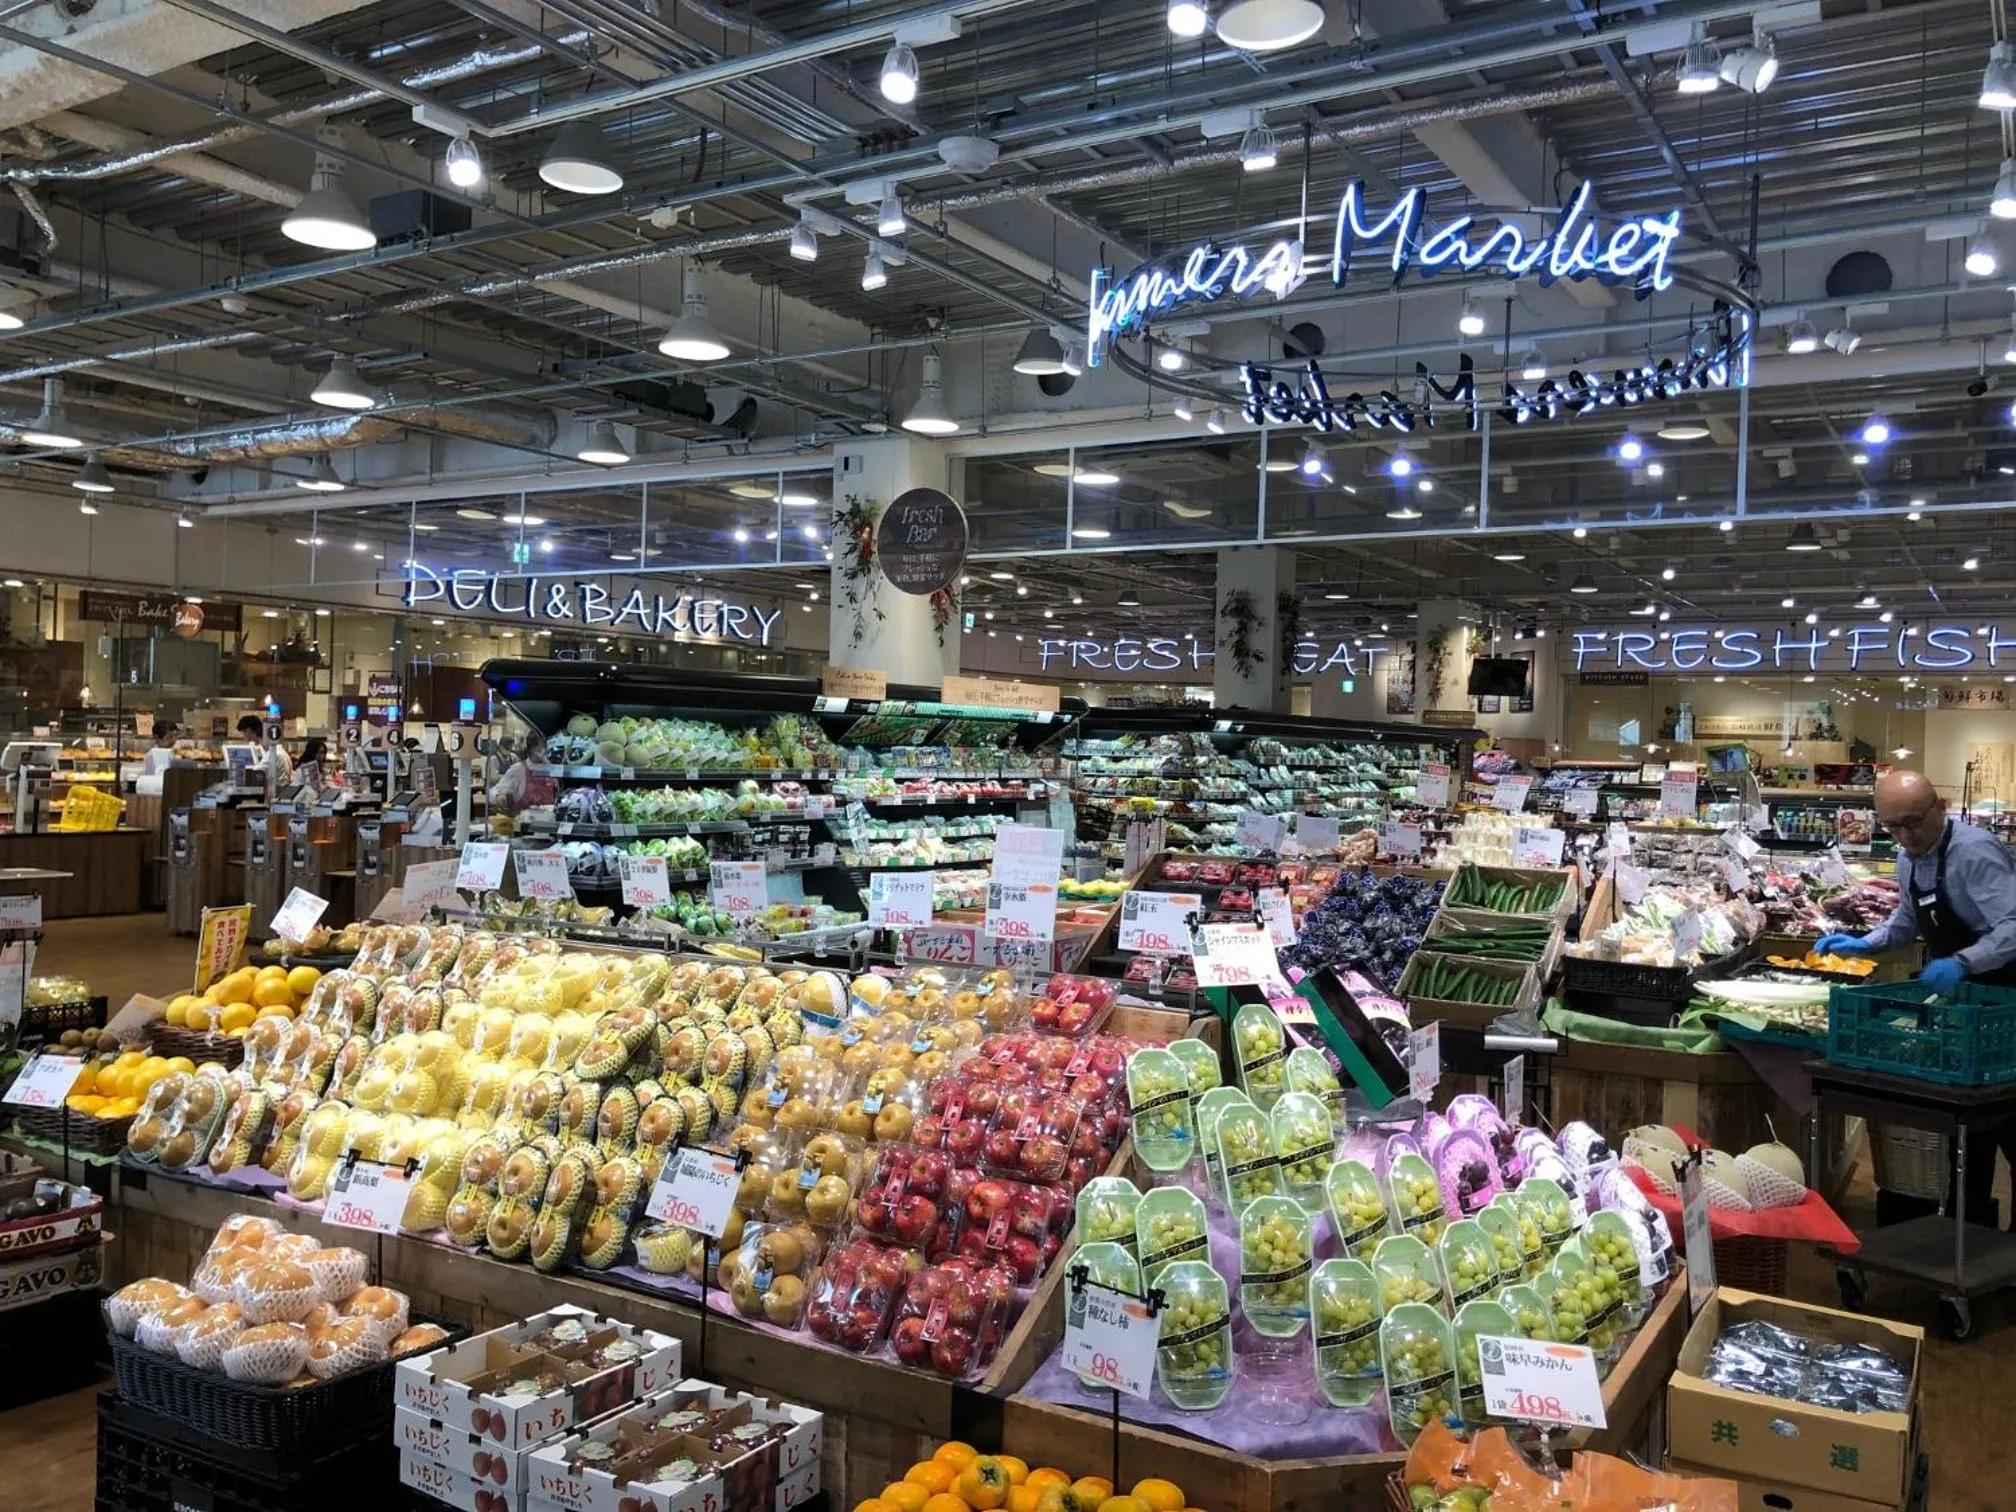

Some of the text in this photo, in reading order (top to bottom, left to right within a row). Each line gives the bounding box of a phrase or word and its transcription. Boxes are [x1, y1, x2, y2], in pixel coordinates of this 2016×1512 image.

[1334, 178, 1681, 293] Market
[1293, 642, 1389, 676] EAT
[1571, 628, 1830, 671] FRESH
[349, 729, 358, 742] 2
[390, 729, 399, 743] 4
[1212, 966, 1251, 983] 798
[338, 1204, 374, 1228] 398
[662, 1199, 700, 1226] 398
[1092, 1352, 1118, 1382] 98
[1504, 1352, 1573, 1372] 味早みかん
[405, 1381, 449, 1413] いちじく
[1509, 1391, 1564, 1419] 498
[405, 1423, 450, 1456] いちじく
[410, 1461, 453, 1494] いちじく
[540, 1473, 593, 1504] いちじく
